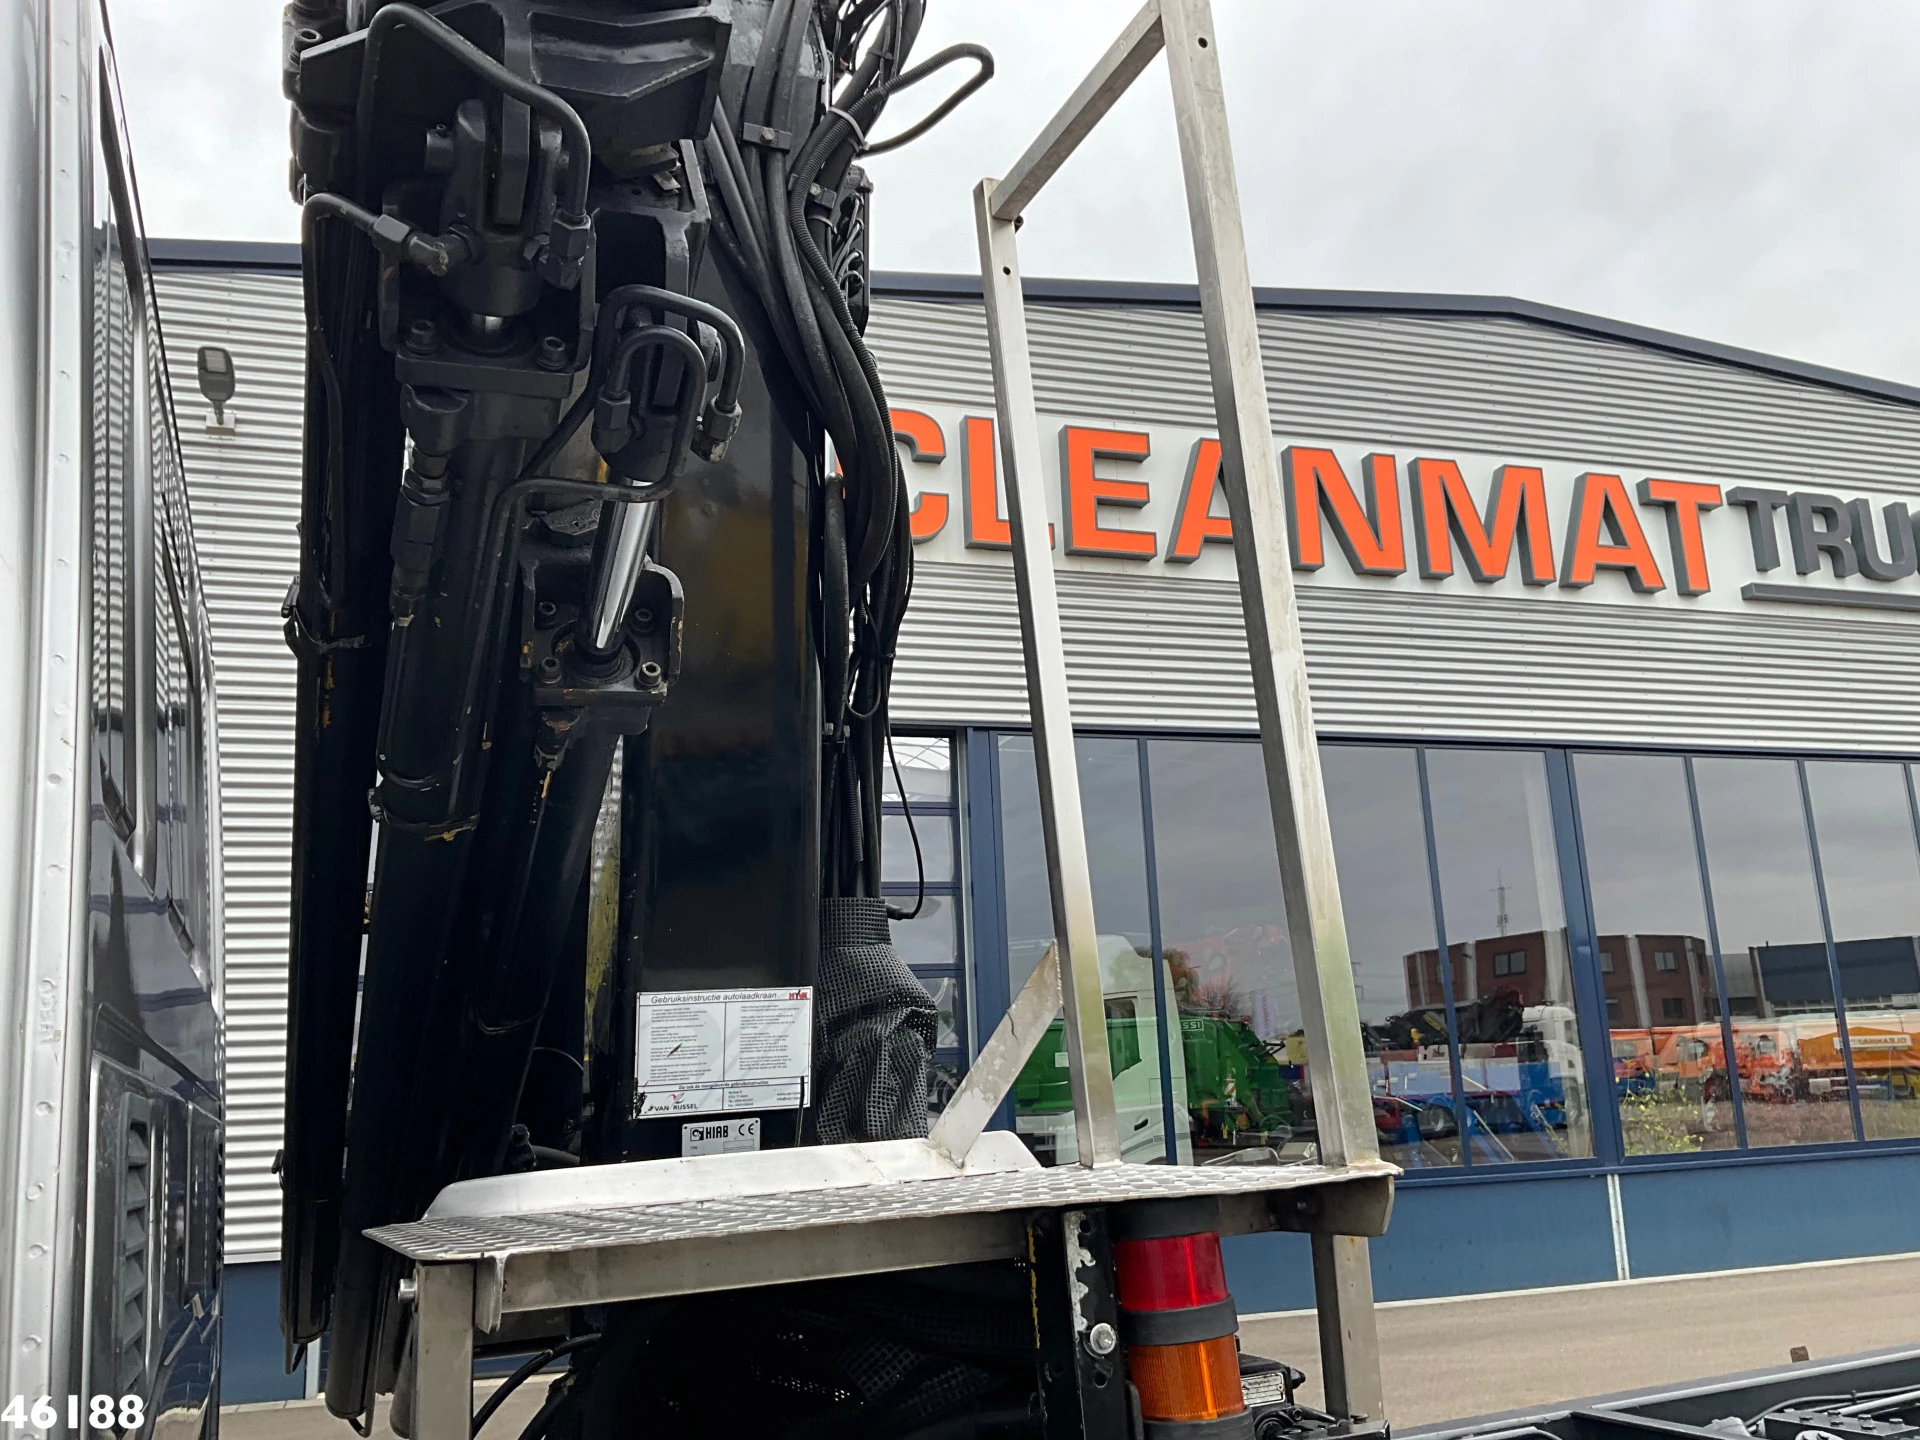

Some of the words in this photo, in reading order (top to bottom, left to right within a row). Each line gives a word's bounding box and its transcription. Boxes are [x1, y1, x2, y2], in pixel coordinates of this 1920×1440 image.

[1726, 485, 1920, 582] TRU
[651, 993, 721, 1004] Gebruiksinstructie
[723, 991, 777, 1001] autolaadkraan
[705, 1125, 729, 1140] HIAB
